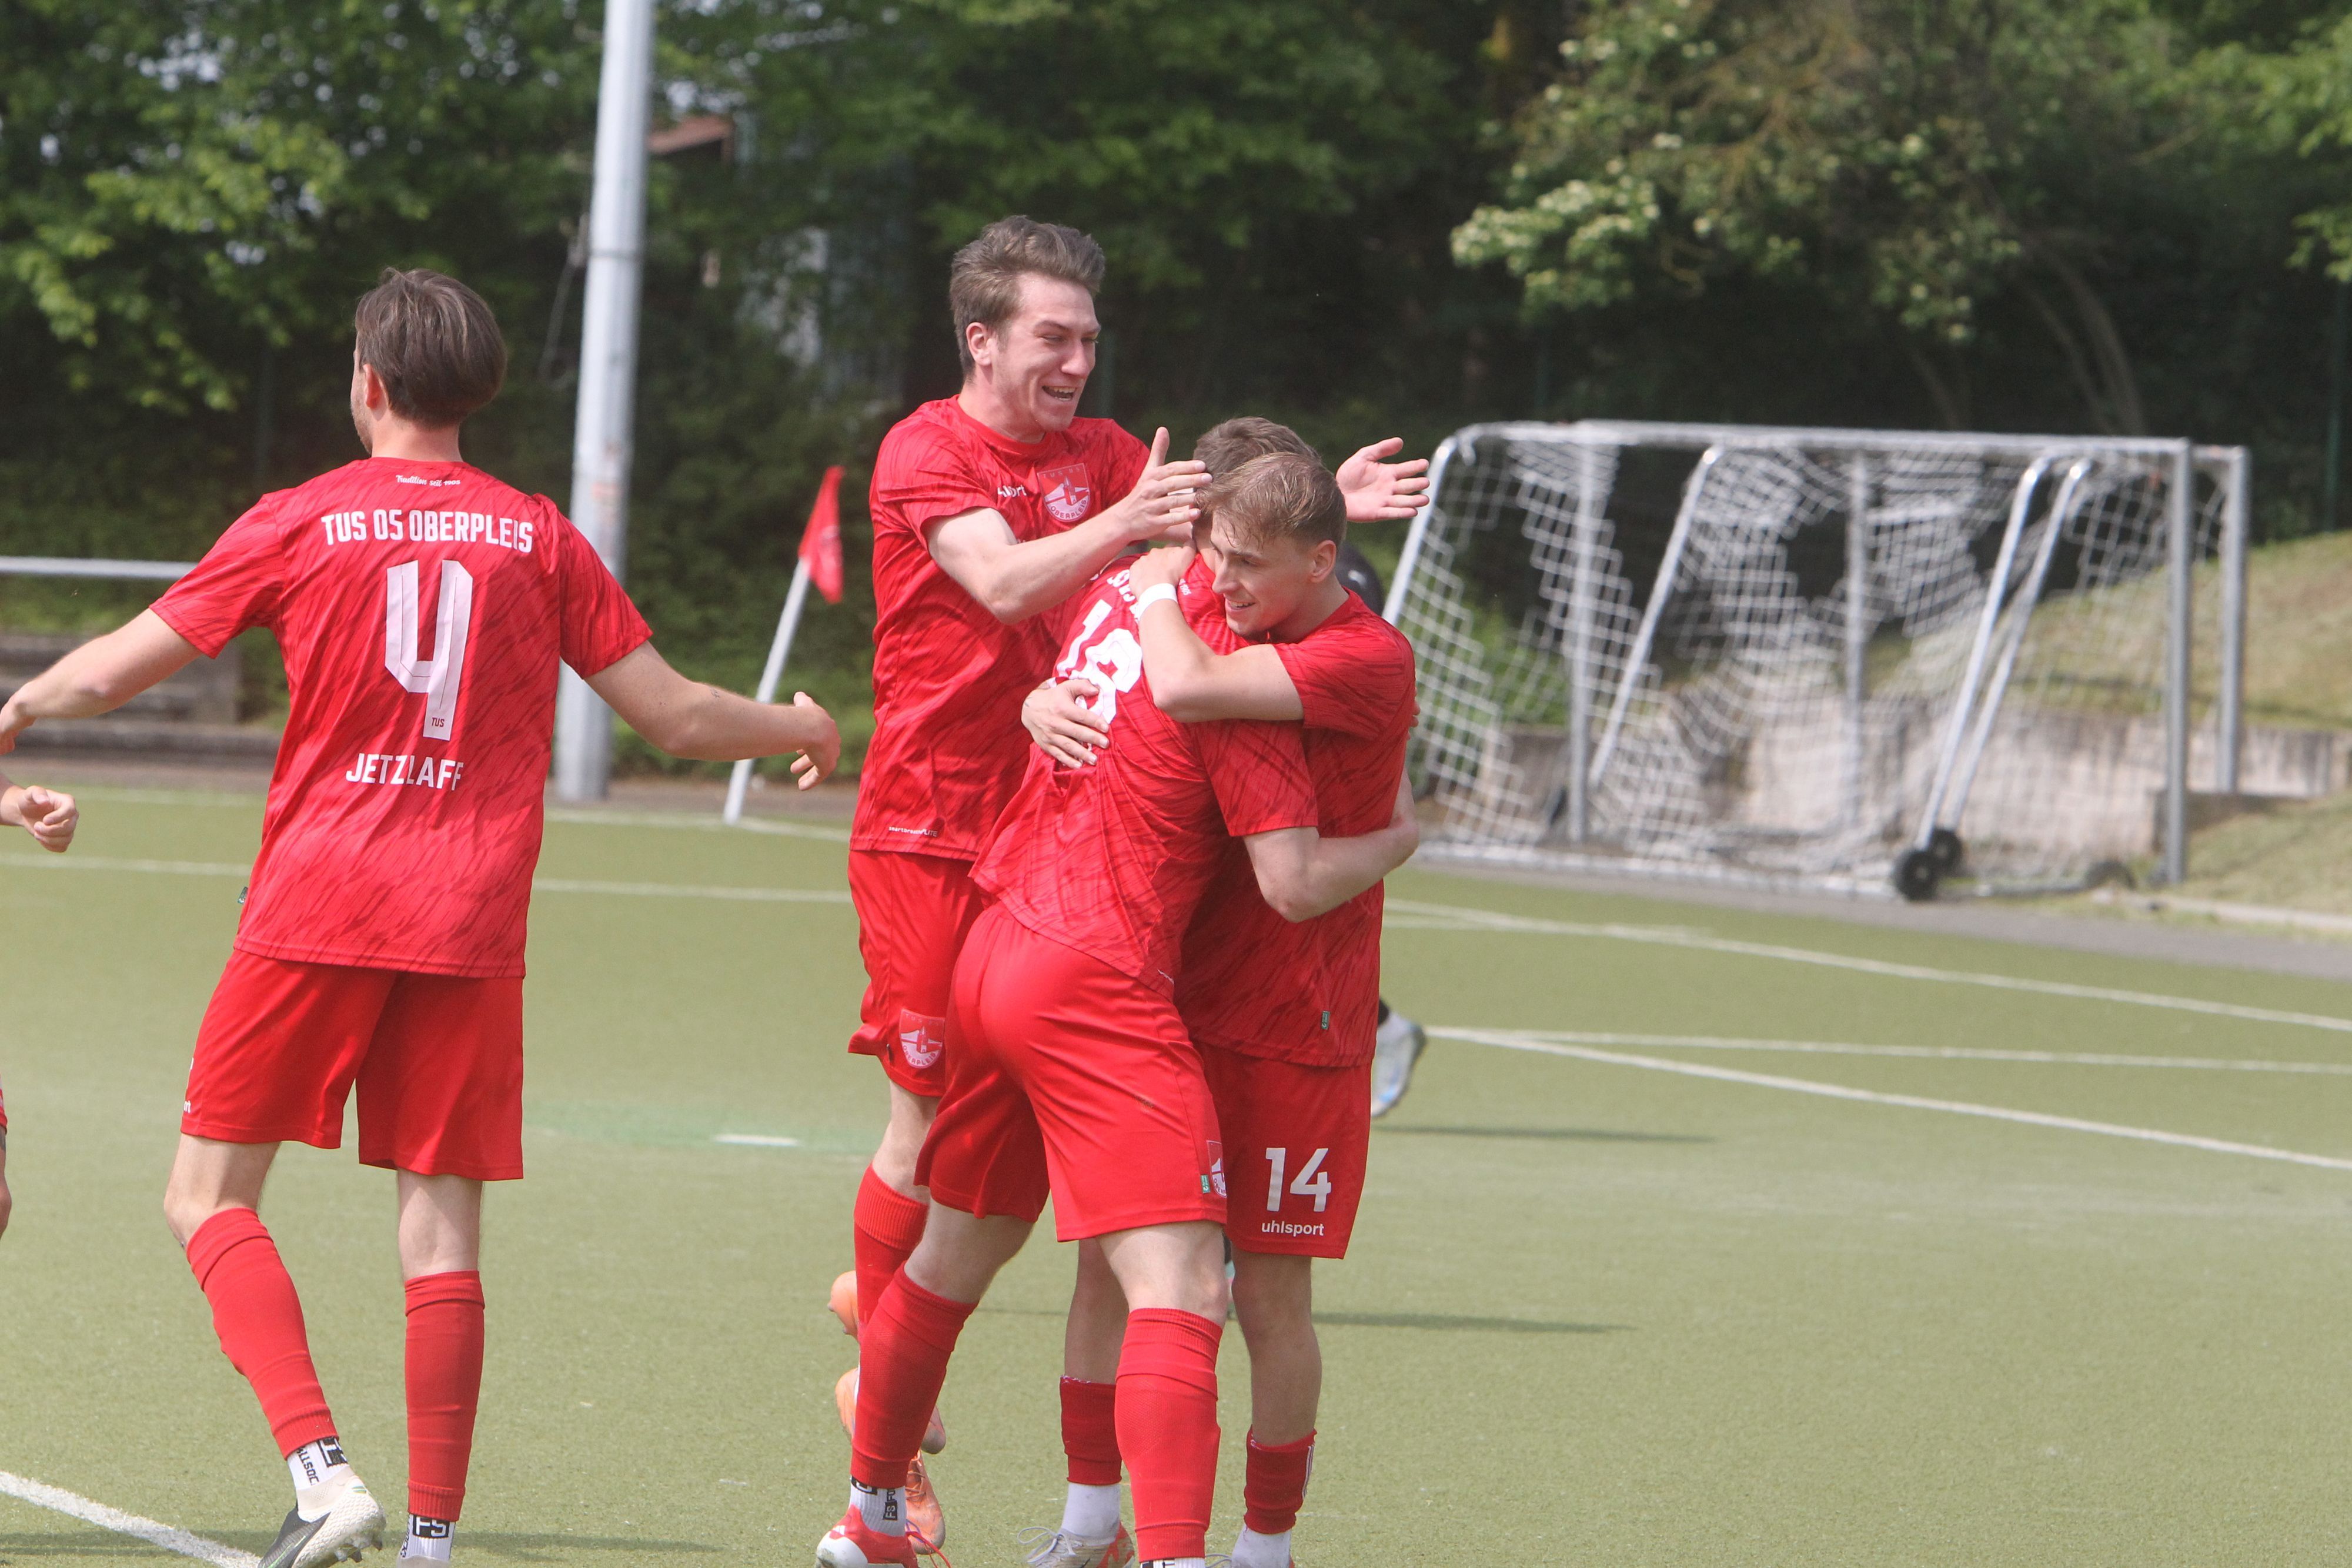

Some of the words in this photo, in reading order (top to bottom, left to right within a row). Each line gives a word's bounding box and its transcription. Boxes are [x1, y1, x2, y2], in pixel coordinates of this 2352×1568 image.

[396, 475, 427, 485] Tradition
[1051, 499, 1087, 519] OBERPLEIS
[321, 510, 367, 546] TUS
[373, 509, 403, 540] 05
[409, 509, 533, 553] OBERPLEIS
[385, 560, 473, 741] 4
[432, 717, 445, 728] TUS
[345, 753, 465, 791] JETZLAFF
[1265, 1147, 1332, 1212] 14
[1261, 1220, 1324, 1237] uhlsport
